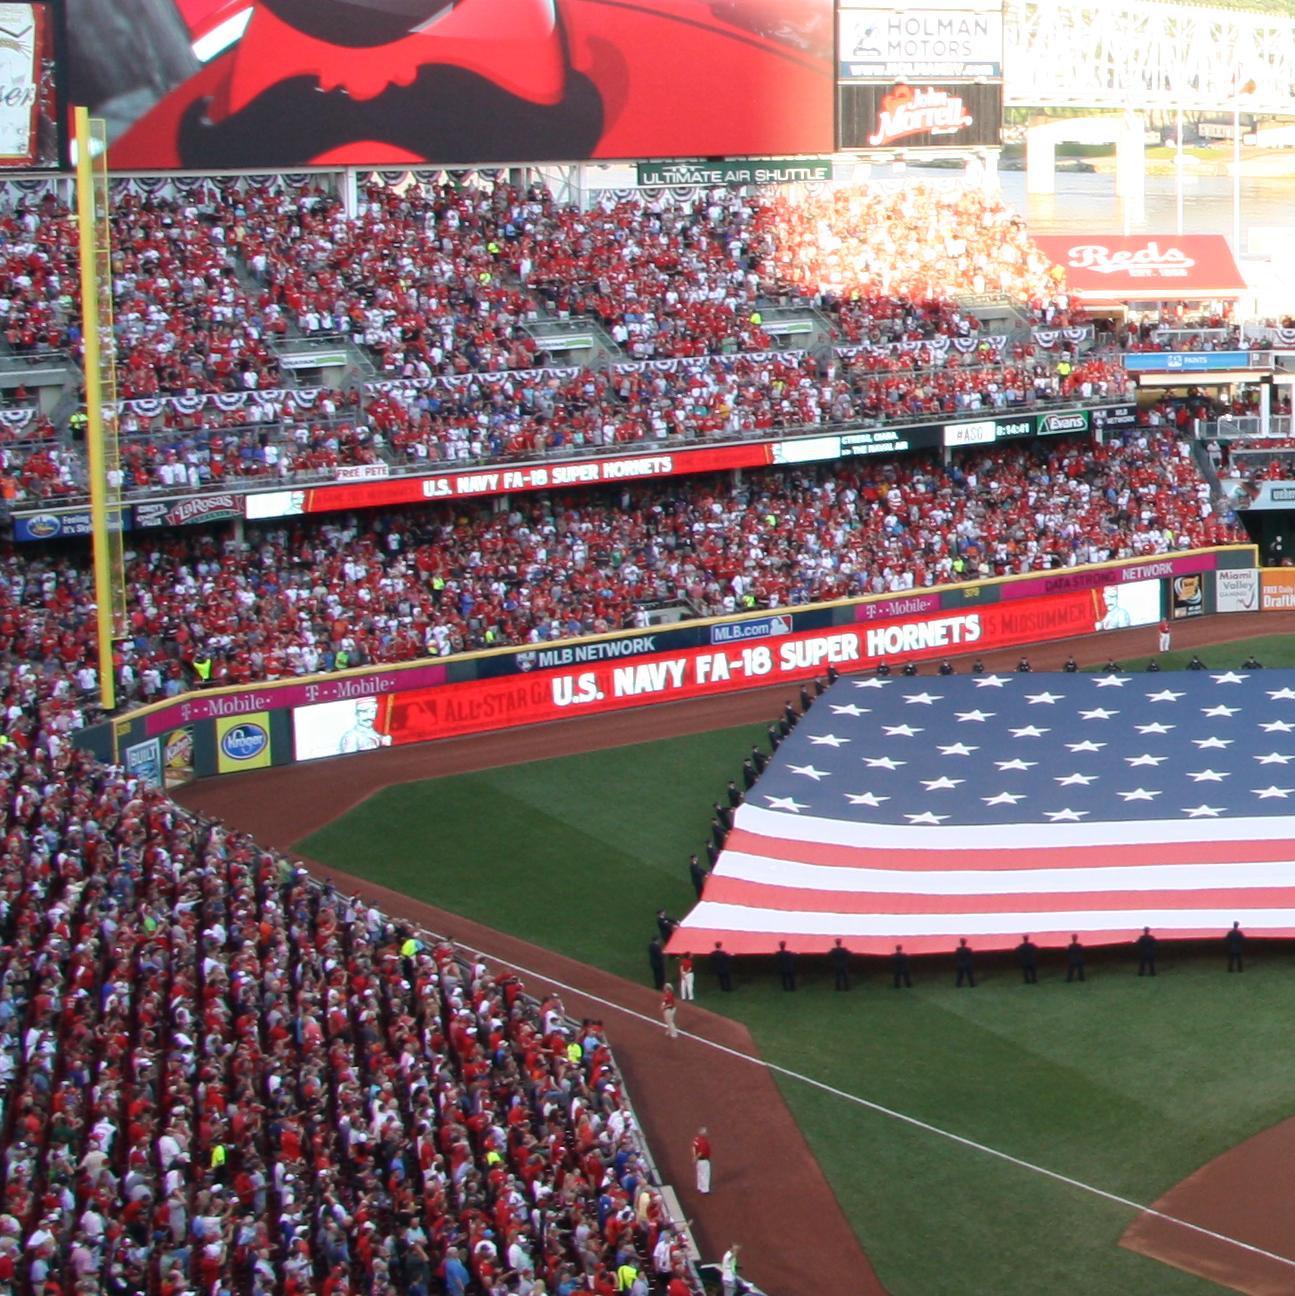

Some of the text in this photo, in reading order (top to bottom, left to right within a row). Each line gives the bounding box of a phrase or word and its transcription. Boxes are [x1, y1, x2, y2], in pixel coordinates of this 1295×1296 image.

[888, 18, 988, 36] HOLMAN
[888, 40, 972, 56] MOTORS
[643, 168, 828, 185] ULTIMATE AIR SHUTTLE
[1068, 242, 1195, 273] Reds
[956, 426, 983, 441] #ASG
[337, 466, 388, 478] FREE PETE
[423, 456, 672, 497] U.S. NAVY FA-18 SUPER HORNETS
[1122, 562, 1174, 581] NETWORK
[1219, 571, 1251, 580] Miami
[1223, 580, 1253, 590] Valley
[714, 622, 770, 642] MLB.com
[538, 651, 574, 668] MLB
[575, 636, 656, 663] NETWORK
[551, 672, 605, 706] U.S.
[613, 658, 686, 697] NAVY
[695, 646, 773, 684] FA-18
[780, 632, 859, 670] SUPER
[867, 613, 982, 656] HORNETS
[227, 729, 264, 754] Kroger
